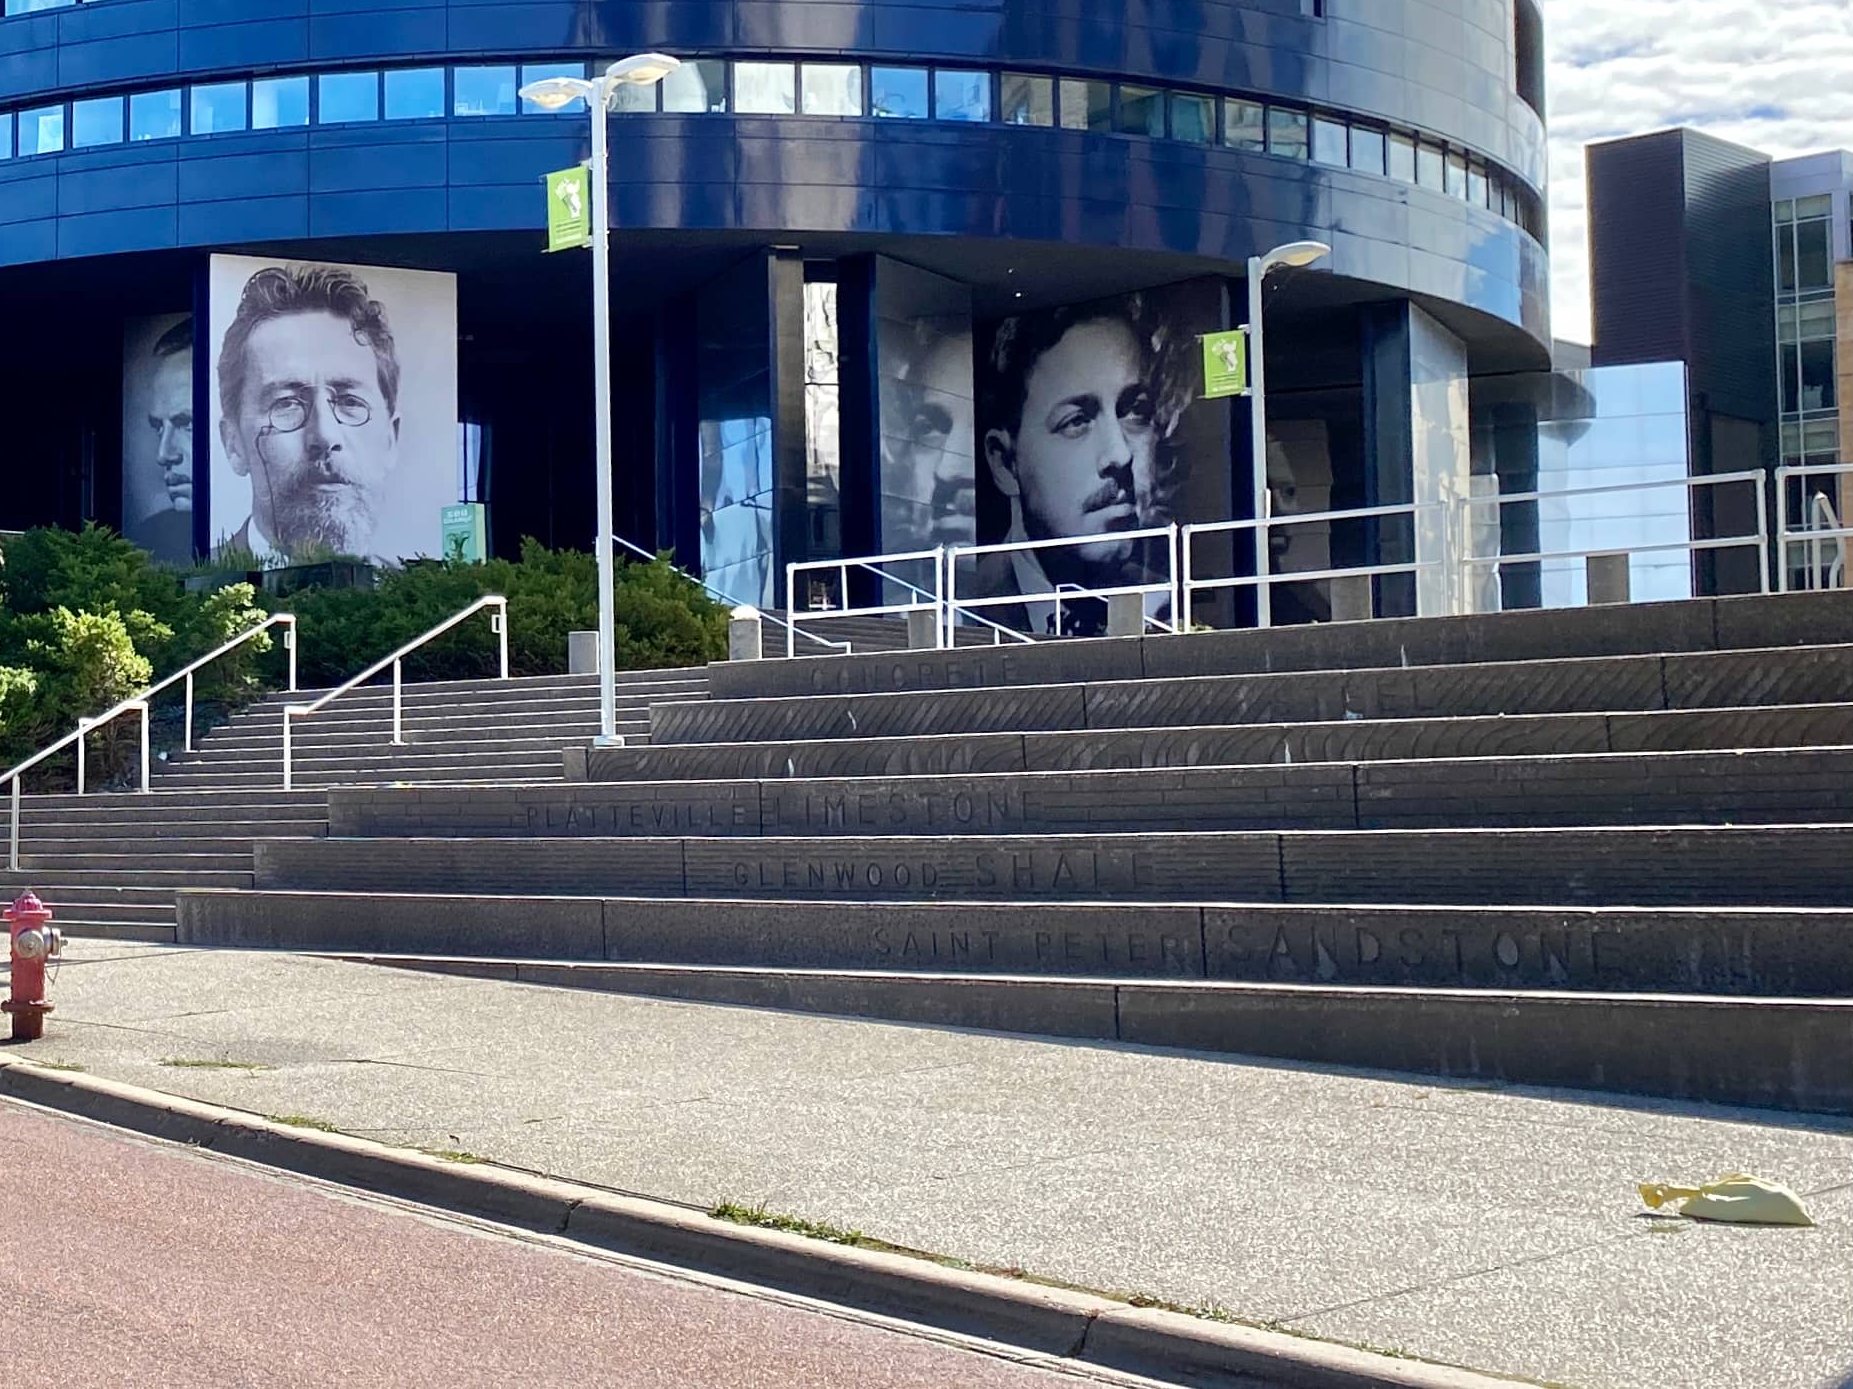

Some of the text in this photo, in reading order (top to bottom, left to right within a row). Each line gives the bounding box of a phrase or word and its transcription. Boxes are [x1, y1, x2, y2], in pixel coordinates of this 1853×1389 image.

[811, 656, 1017, 691] CONCRETE
[525, 790, 1044, 829] PLATTEVILLE LIMESTONE
[733, 852, 1153, 888] GLENWOOD SHALE
[872, 925, 1621, 978] SAINT PETER SANDSTONE
